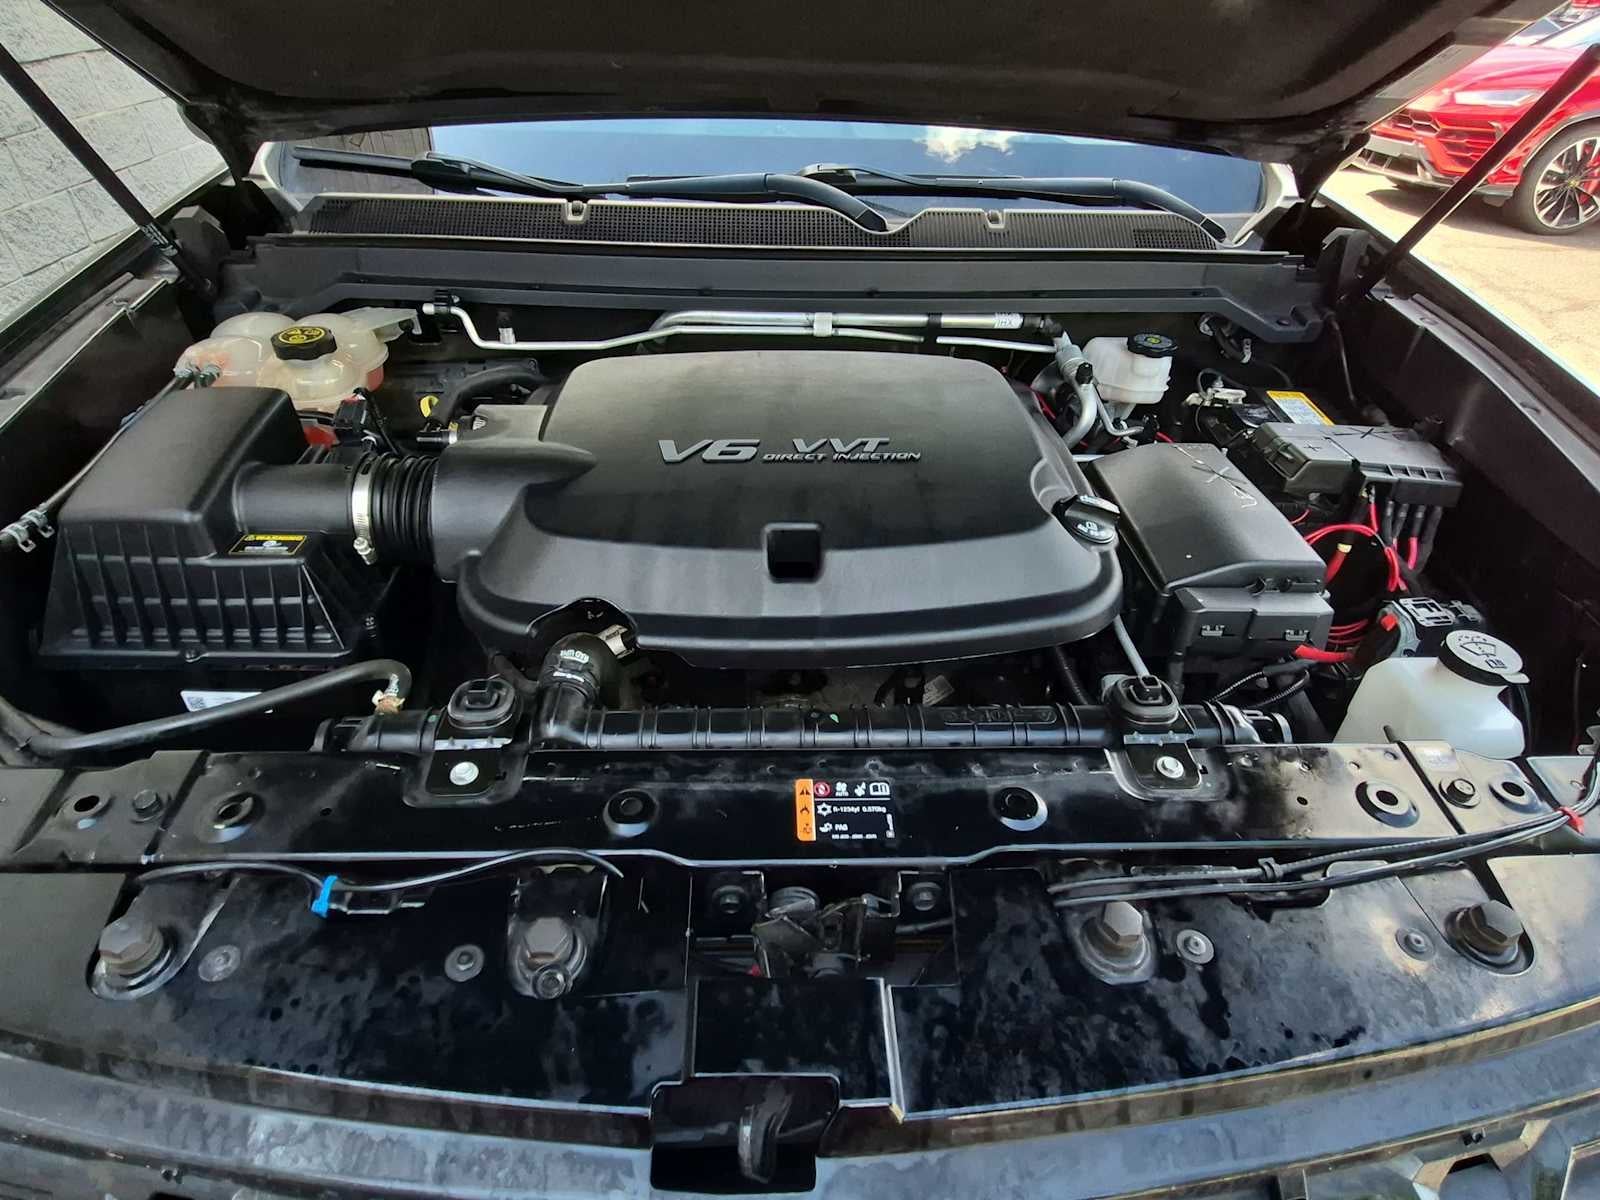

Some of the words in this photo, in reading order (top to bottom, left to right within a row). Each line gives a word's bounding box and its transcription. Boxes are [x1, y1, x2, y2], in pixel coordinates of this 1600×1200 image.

[657, 439, 760, 463] V6
[792, 437, 889, 453] VVT
[762, 452, 827, 463] DIRECT
[832, 451, 921, 463] INJECTION
